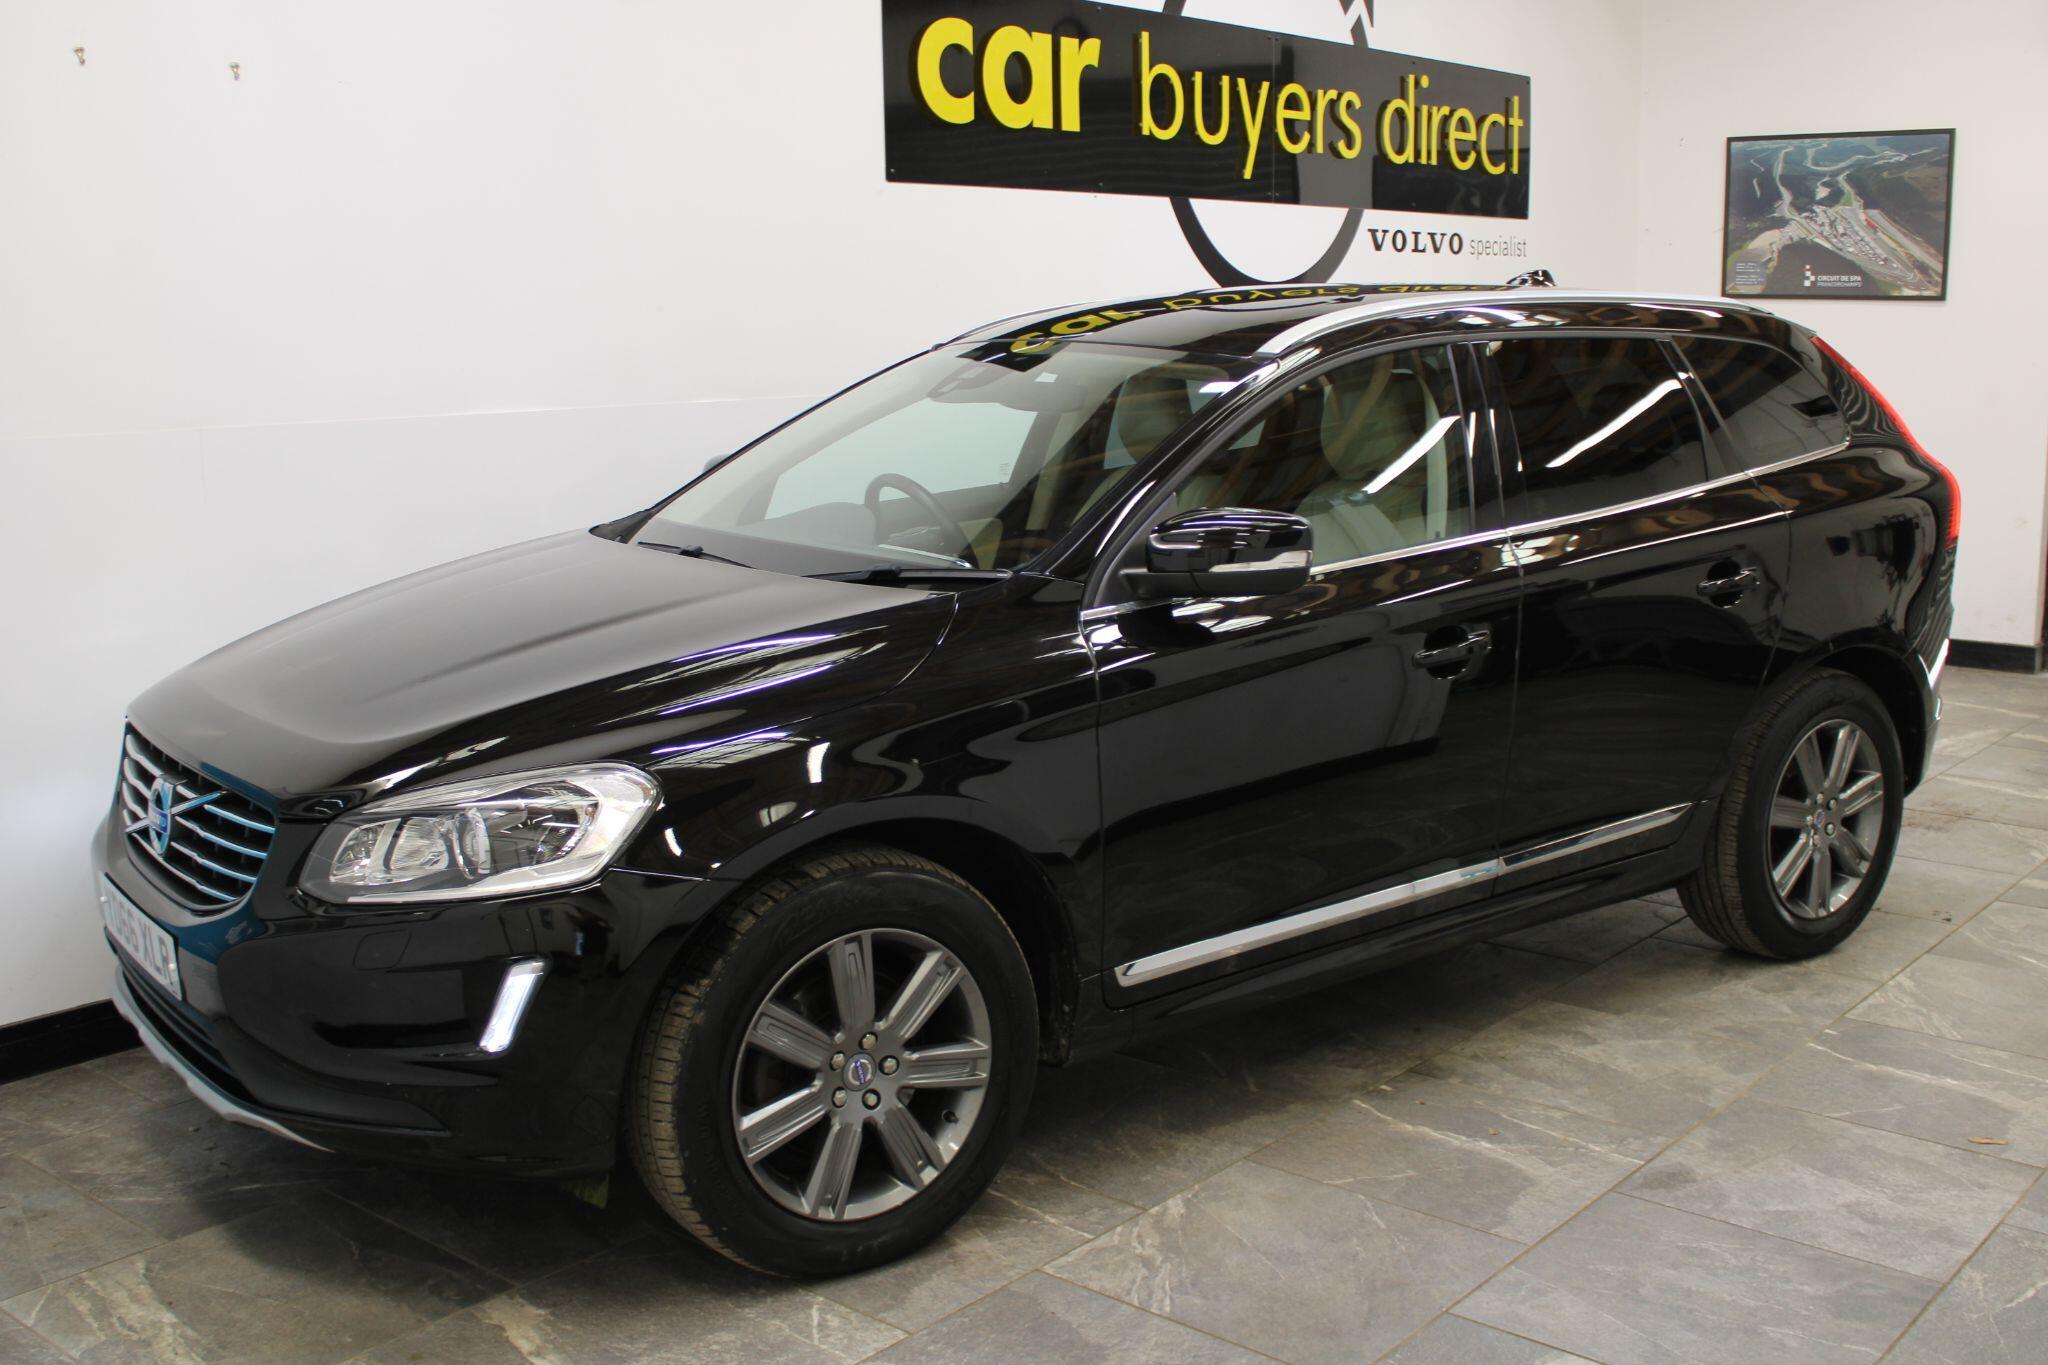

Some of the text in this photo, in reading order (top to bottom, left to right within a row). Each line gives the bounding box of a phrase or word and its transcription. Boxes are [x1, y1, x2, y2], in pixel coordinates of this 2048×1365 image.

[916, 17, 1525, 180] car buyers direct
[1367, 228, 1528, 261] VOLVO specialist
